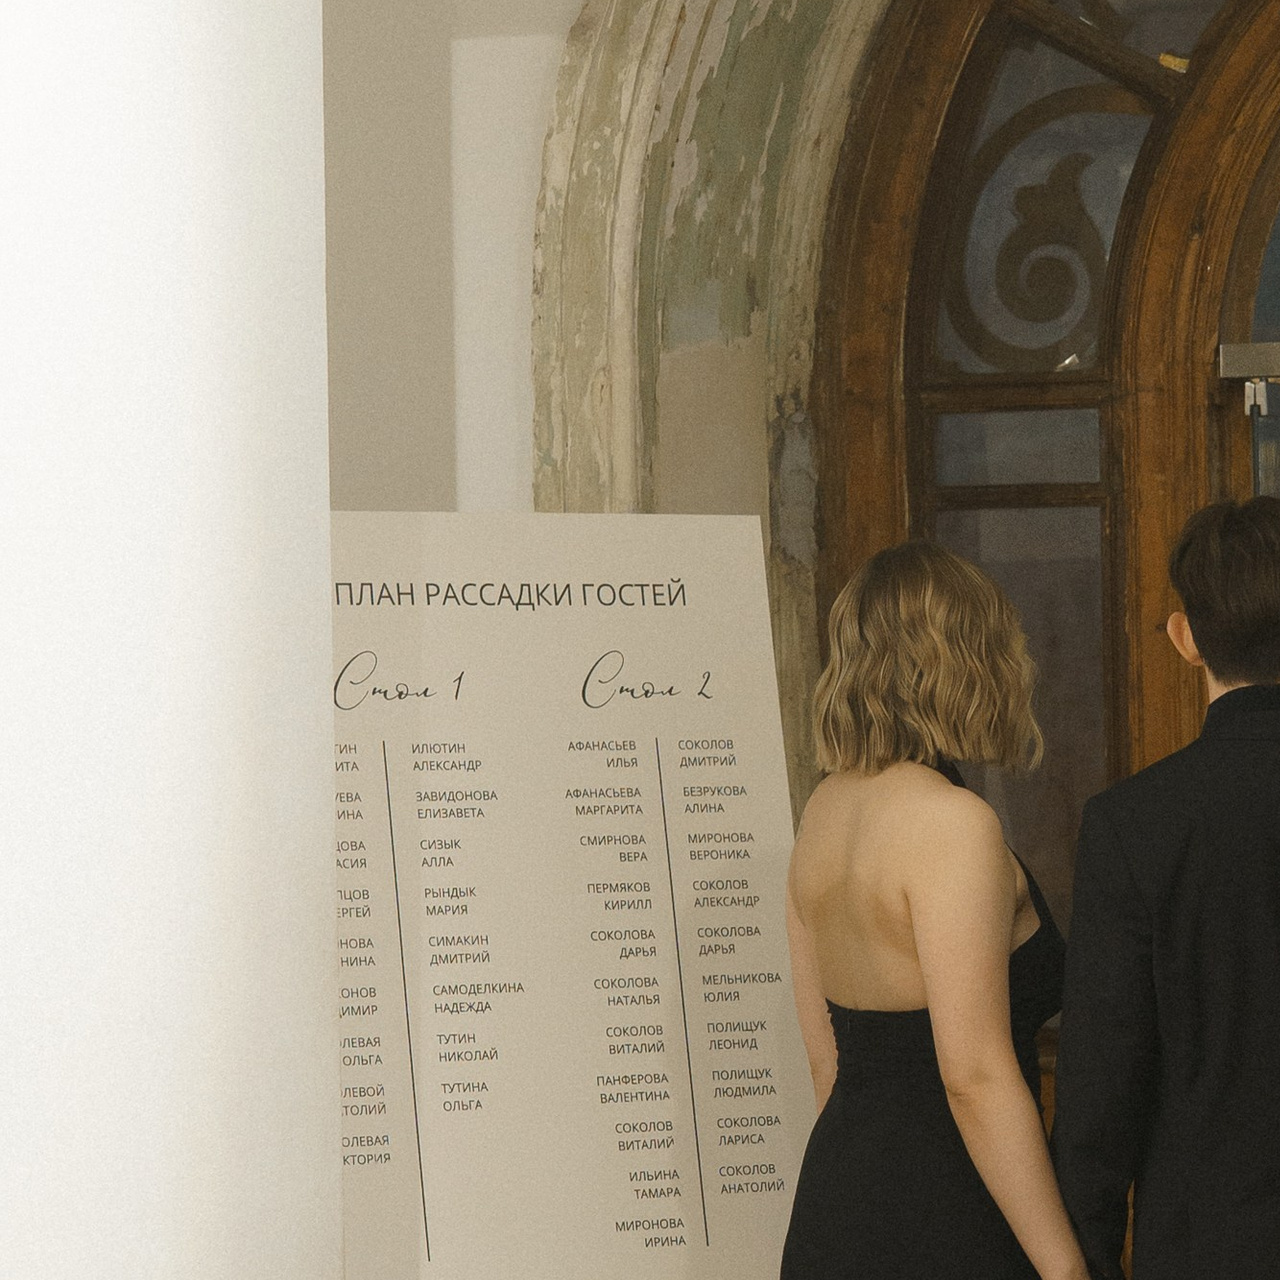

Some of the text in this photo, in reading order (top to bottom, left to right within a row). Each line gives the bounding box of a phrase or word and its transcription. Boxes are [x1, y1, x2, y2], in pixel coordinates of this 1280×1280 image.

[335, 578, 686, 611] ПЛАН РАССАДКИ ГОСТЕЙ
[334, 651, 465, 710] Стол 1
[581, 650, 713, 709] Стол 2
[411, 742, 466, 755] ИЛЮТИН
[567, 739, 637, 752] АФАНАСЬЕВ
[677, 739, 734, 751] СОКОЛОВ
[412, 759, 482, 773] АЛЕКСАНДР
[606, 757, 639, 768] ИЛЬЯ
[679, 753, 737, 769] ДМИТРИЙ
[415, 789, 499, 804] ЗАВИДОНОВА
[564, 787, 642, 799] АФАНАСЬЕВА
[682, 785, 748, 798] БЕЗРУКОВА
[416, 807, 486, 820] ЕЛИЗАВЕТА
[574, 804, 644, 816] МАРГАРИТА
[684, 802, 725, 814] АЛИНА
[419, 838, 462, 851] СИЗЫК
[579, 834, 647, 847] СМИРНОВА
[687, 832, 755, 844] МИРОНОВА
[618, 851, 649, 863] ВЕРА
[689, 848, 751, 861] ВЕРОНИКА
[421, 856, 455, 868] АЛЛА
[586, 881, 651, 894] ПЕРМЯКОВ
[692, 878, 749, 892] СОКОЛОВ
[424, 886, 477, 900] РЫНДЫК
[604, 898, 653, 911] КИРИЛЛ
[693, 895, 761, 908] АЛЕКСАНДР
[425, 904, 469, 916] МАРИЯ
[589, 928, 656, 942] СОКОЛОВА
[696, 925, 762, 939] СОКОЛОВА
[338, 937, 375, 950] НОВА
[428, 934, 489, 948] СИМАКИН
[618, 945, 657, 960] ДАРЬЯ
[698, 943, 736, 957] ДАРЬЯ
[341, 955, 376, 968] НИНА
[429, 950, 491, 967] ДМИТРИЙ
[593, 976, 659, 990] СОКОЛОВА
[701, 972, 783, 986] МЕЛЬНИКОВА
[432, 982, 525, 997] САМОДЕЛКИНА
[703, 990, 740, 1003] ЮЛИЯ
[607, 993, 661, 1007] НАТАЛЬЯ
[339, 1004, 379, 1019] ИМИР
[434, 1000, 493, 1016] НАДЕЖДА
[605, 1024, 664, 1038] СОКОЛОВ
[706, 1020, 767, 1034] ПОЛИЩУК
[340, 1036, 381, 1049] ЛЕВАЯ
[436, 1033, 477, 1045] ТУТИН
[708, 1037, 759, 1051] ЛЕОНИД
[608, 1039, 666, 1055] ВИТАЛИЙ
[342, 1054, 383, 1067] ОЛЬГА
[438, 1047, 499, 1063] НИКОЛАЙ
[596, 1073, 670, 1087] ПАНФЕРОВА
[711, 1068, 773, 1081] ПОЛИЩУК
[341, 1083, 385, 1099] ЛЕВОЙ
[440, 1081, 489, 1094] ТУТИНА
[713, 1084, 777, 1099] ЛЮДМИЛА
[599, 1090, 671, 1105] ВАЛЕНТИНА
[442, 1099, 483, 1113] ОЛЬГА
[614, 1120, 674, 1135] СОКОЛОВ
[716, 1115, 782, 1129] СОКОЛОВА
[342, 1134, 390, 1148] ОЛЕВАЯ
[617, 1135, 675, 1152] ВИТАЛИЙ
[718, 1133, 766, 1146] ЛАРИСА
[343, 1152, 391, 1166] КТОРИЯ
[628, 1169, 680, 1183] ИЛЬИНА
[718, 1163, 777, 1178] СОКОЛОВ
[633, 1186, 682, 1200] ТАМАРА
[720, 1178, 785, 1195] АНАТОЛИЙ
[614, 1217, 685, 1232] МИРОНОВА
[644, 1235, 687, 1248] ИРИНА
